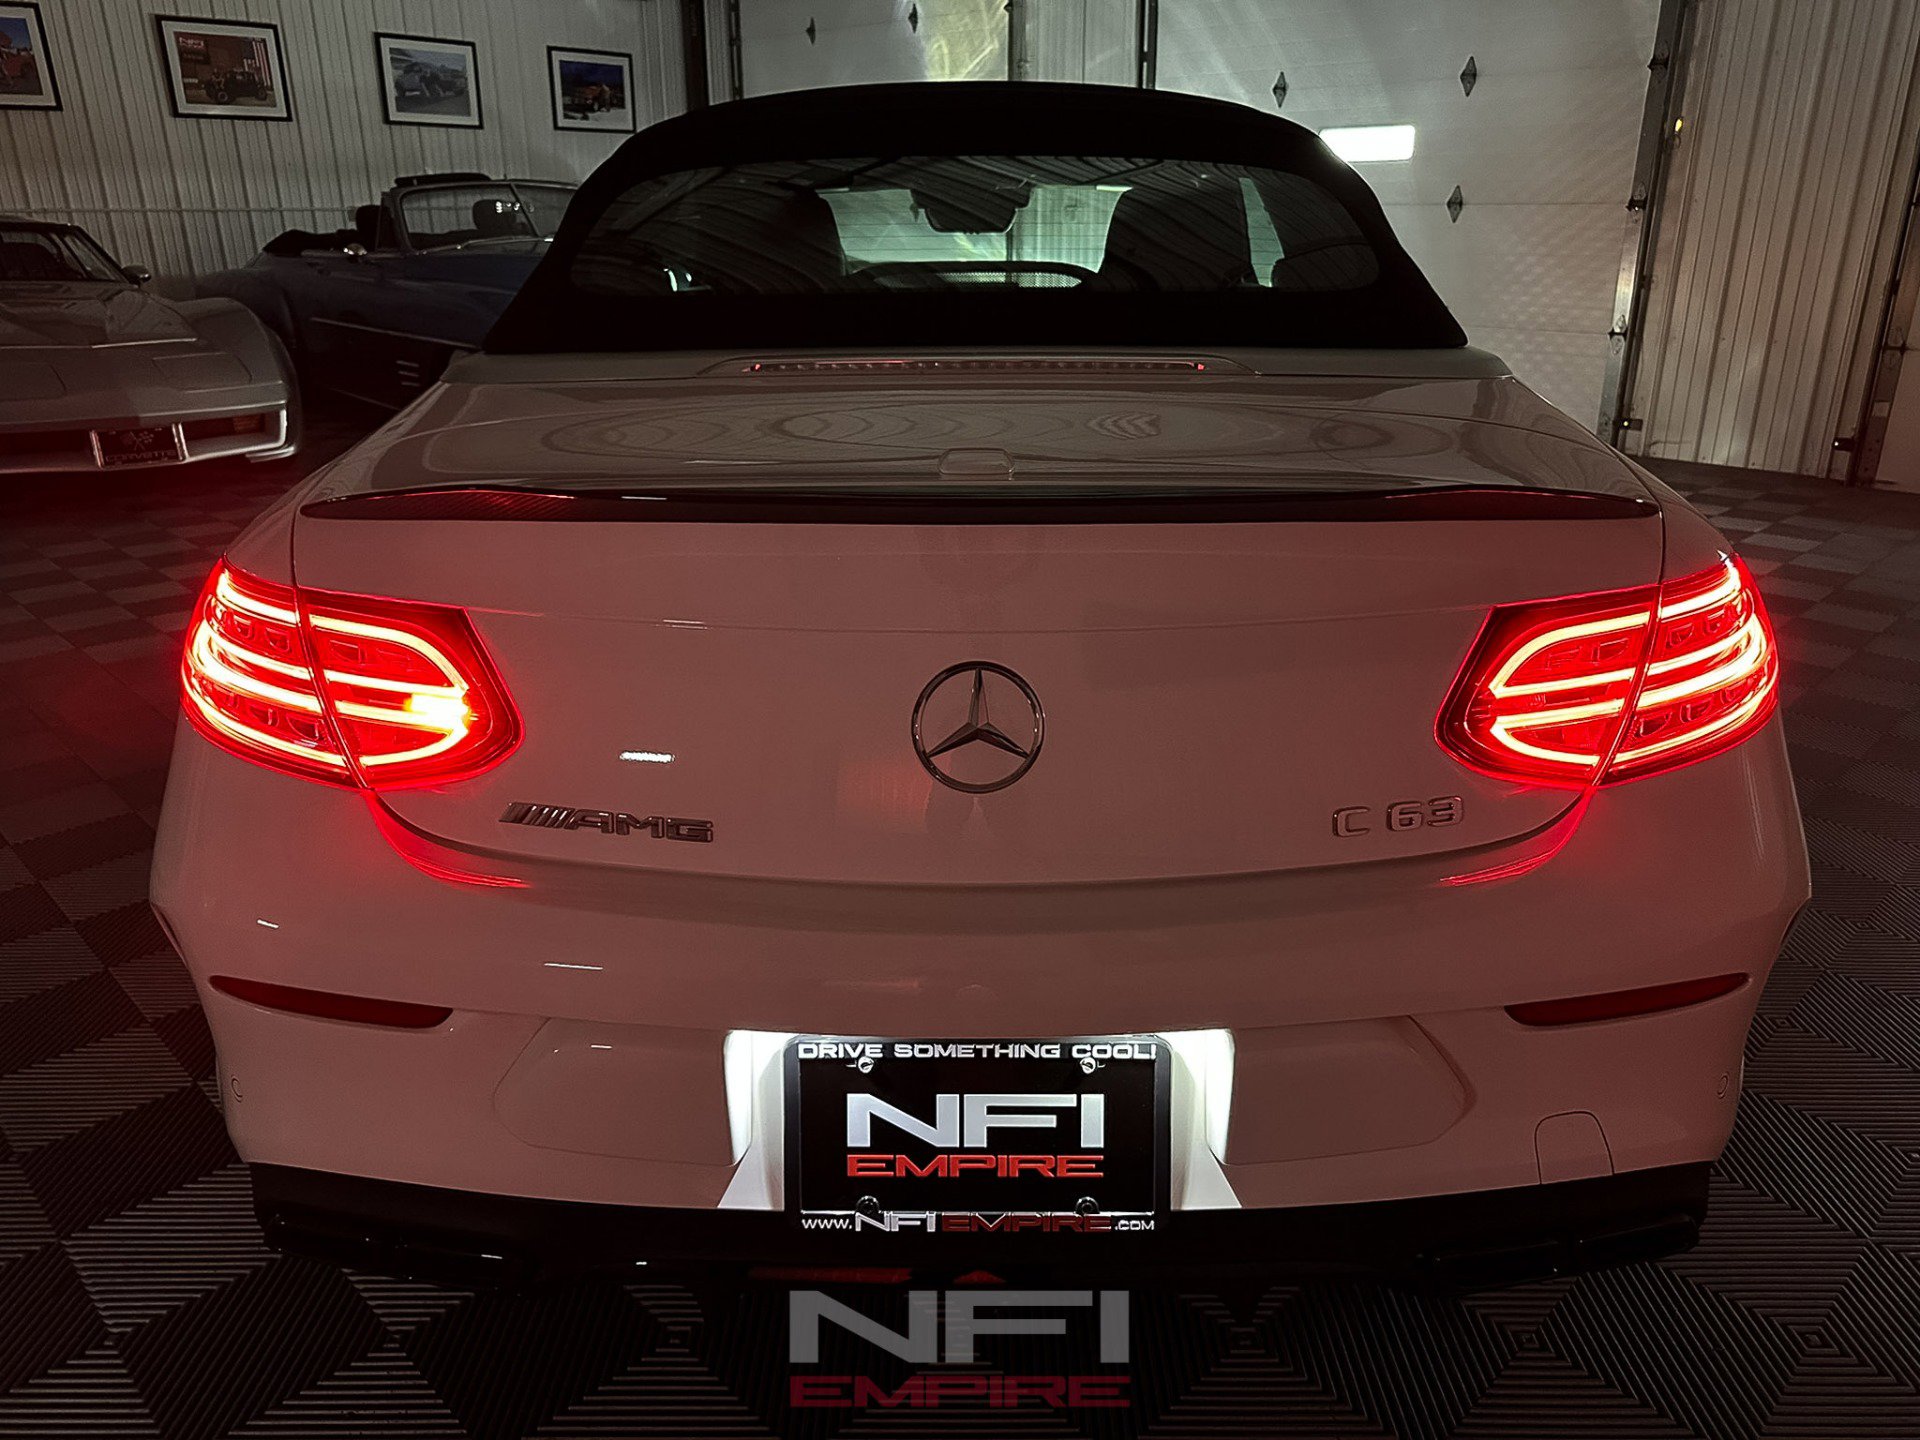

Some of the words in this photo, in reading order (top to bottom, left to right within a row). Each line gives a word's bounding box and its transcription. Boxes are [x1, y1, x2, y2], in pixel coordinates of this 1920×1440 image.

[564, 808, 713, 843] AMG
[1332, 806, 1370, 837] C
[1386, 796, 1464, 832] 63
[798, 1043, 883, 1059] DRIVE
[894, 1043, 1060, 1059] SOMETHING
[1071, 1043, 1156, 1060] COOL!
[846, 1093, 1104, 1148] NFI
[846, 1154, 1104, 1178] EMPIRE
